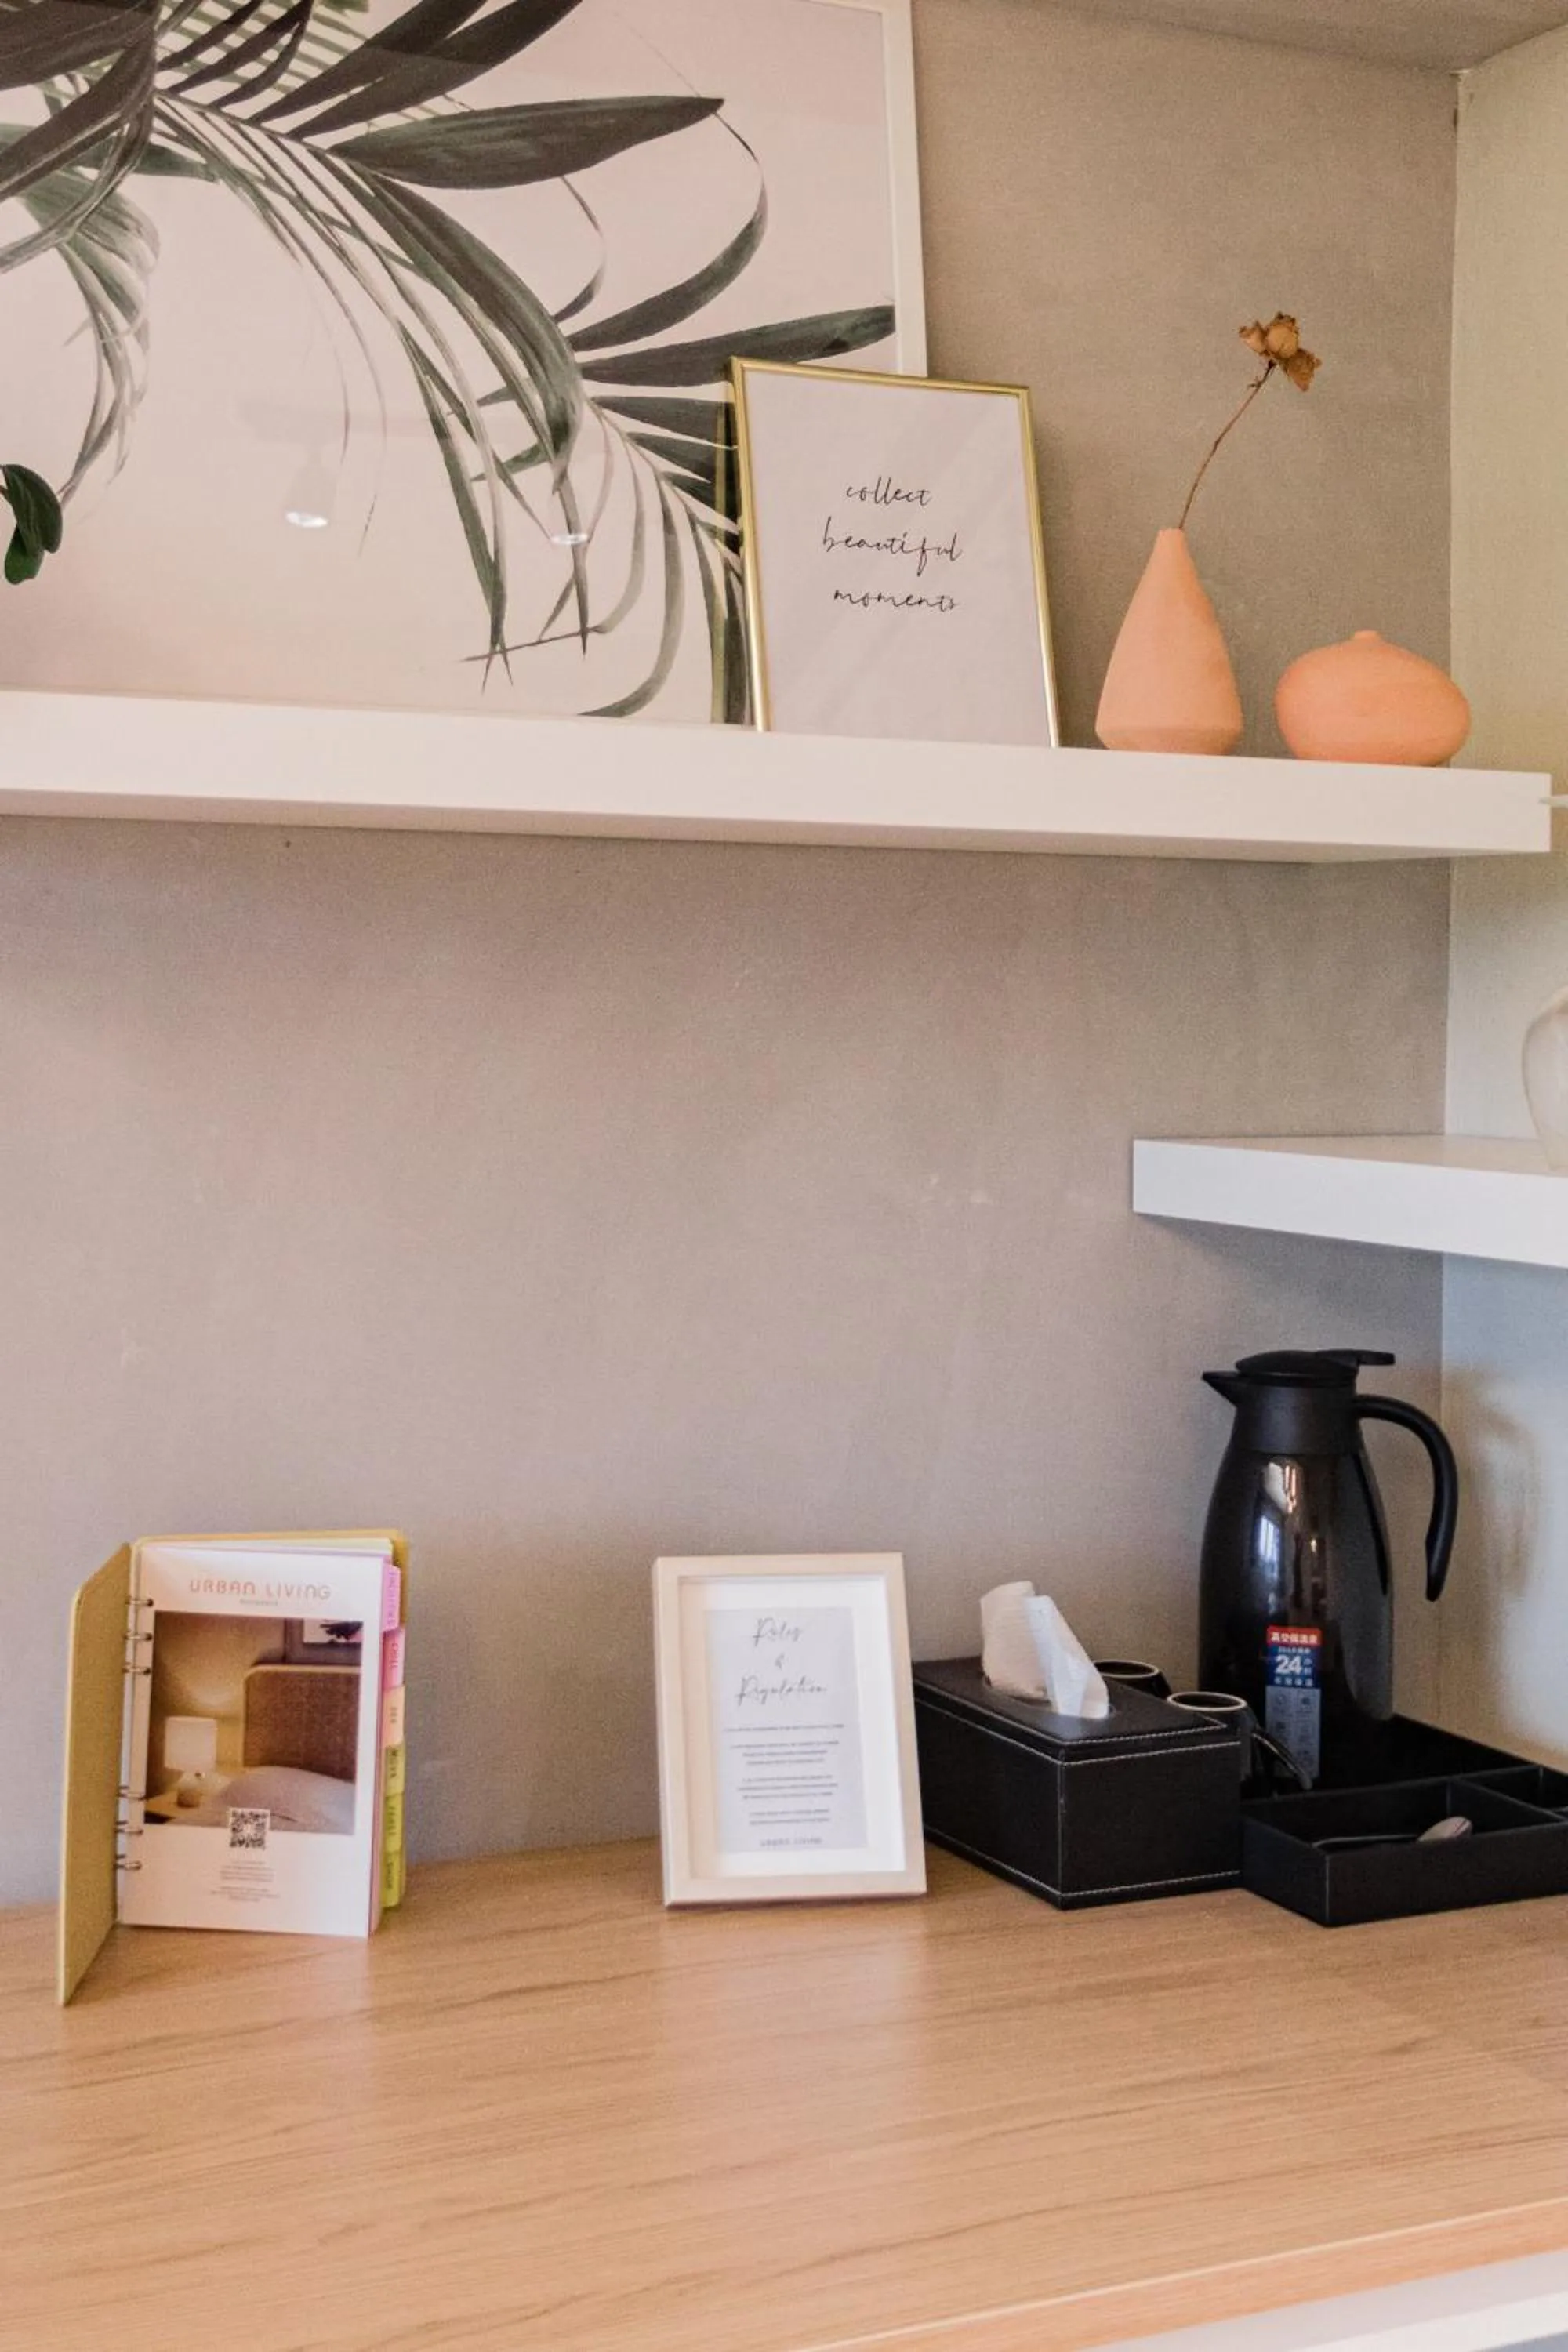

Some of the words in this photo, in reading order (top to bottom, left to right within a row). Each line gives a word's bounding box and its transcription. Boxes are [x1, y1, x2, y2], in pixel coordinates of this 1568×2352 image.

[845, 476, 934, 506] collect
[822, 516, 964, 577] beautiful
[833, 588, 958, 612] moments
[189, 1579, 256, 1595] URBAN
[266, 1582, 332, 1601] LIVING
[1274, 1654, 1303, 1675] 24
